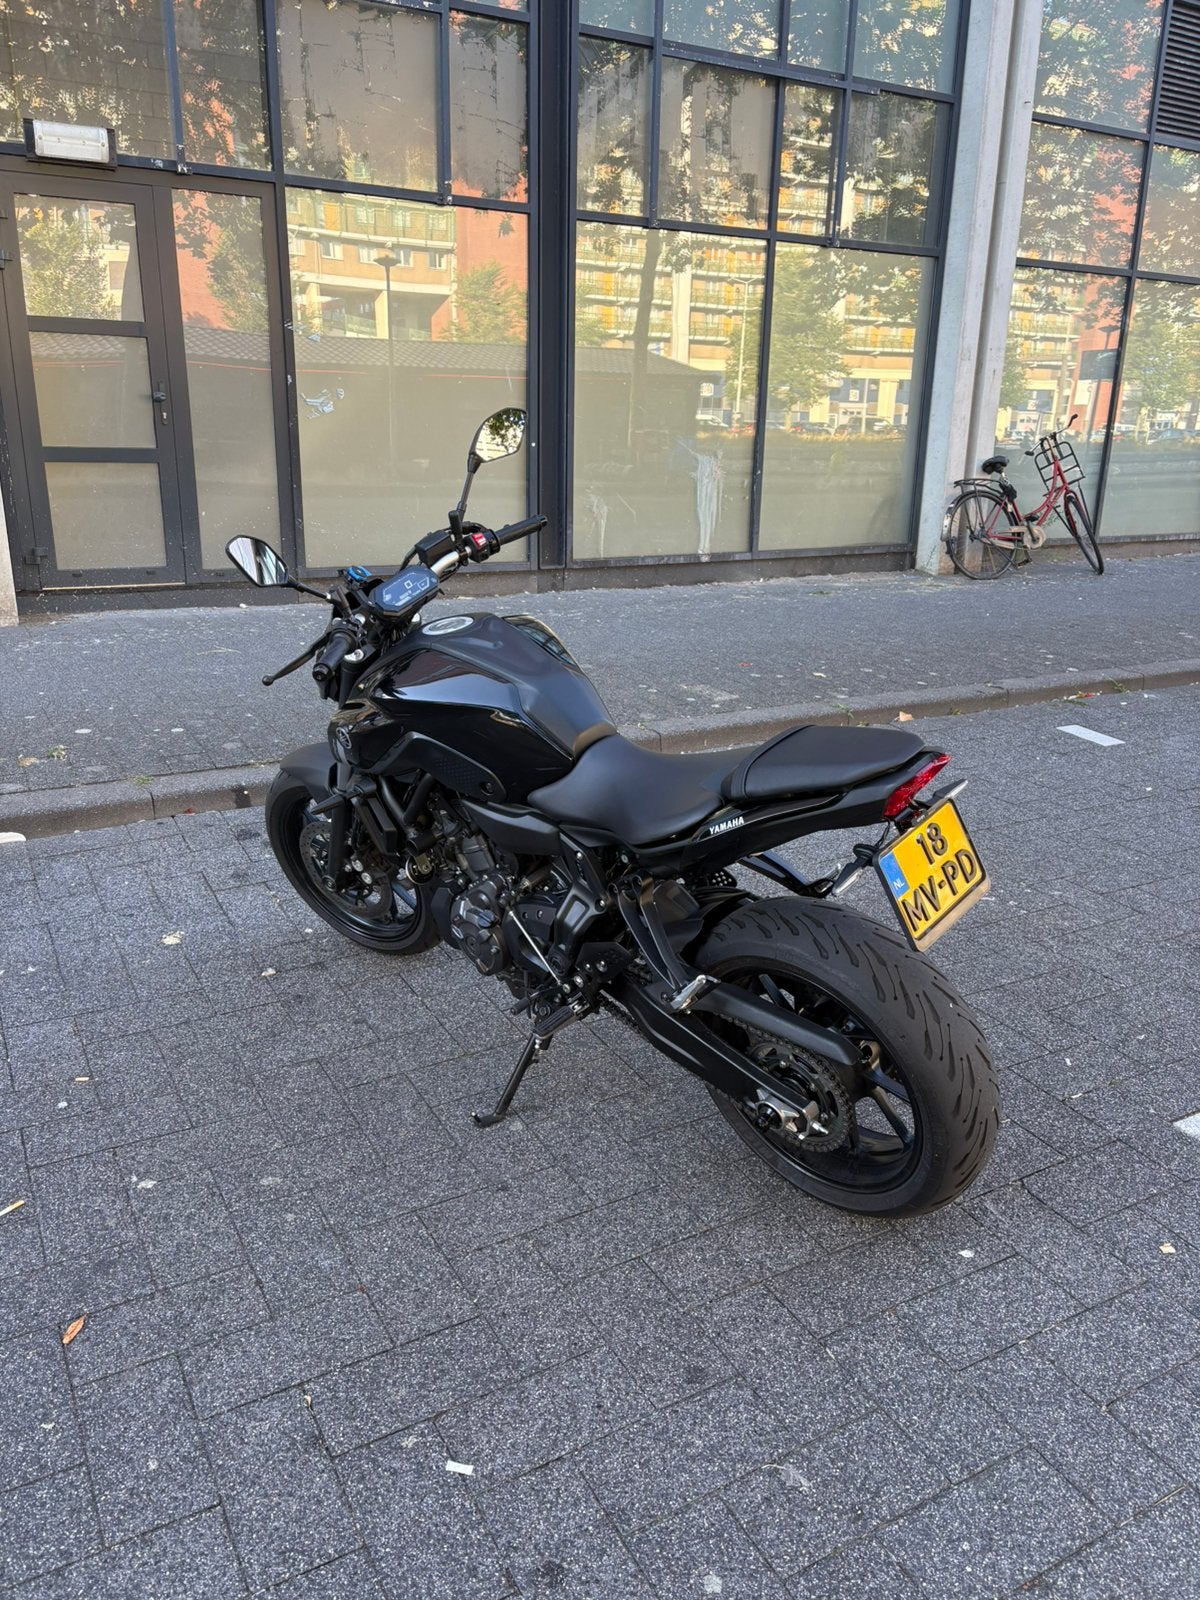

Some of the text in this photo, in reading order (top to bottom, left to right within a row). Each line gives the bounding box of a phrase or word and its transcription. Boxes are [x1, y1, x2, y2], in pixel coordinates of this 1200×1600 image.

[709, 816, 744, 835] YAMAHA
[916, 822, 948, 865] 18
[893, 877, 905, 890] NL
[901, 848, 977, 932] MV-PD
